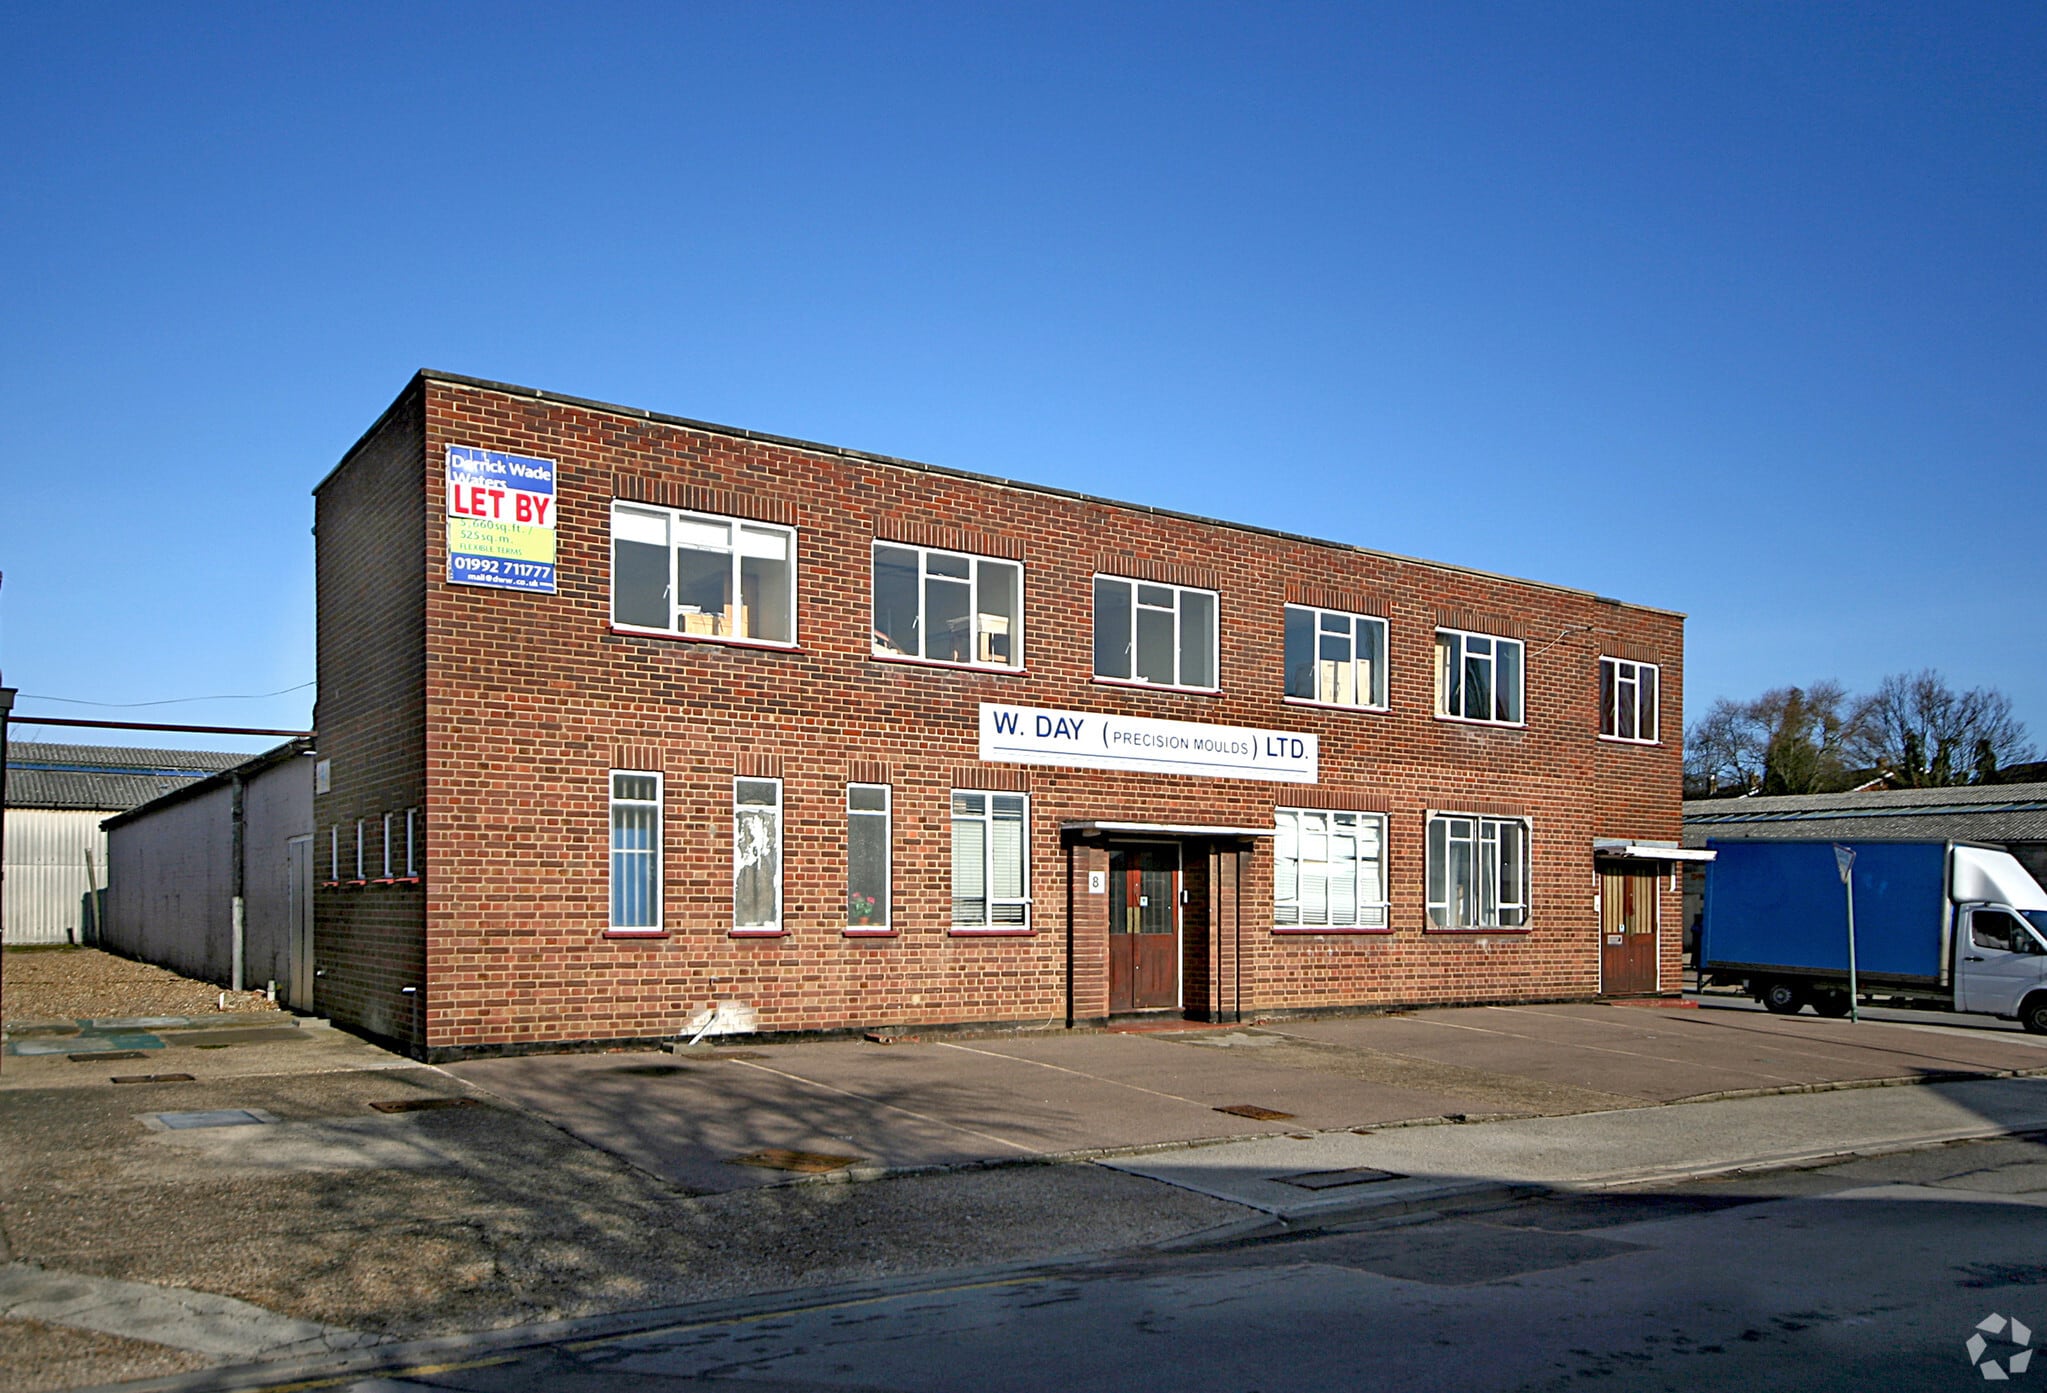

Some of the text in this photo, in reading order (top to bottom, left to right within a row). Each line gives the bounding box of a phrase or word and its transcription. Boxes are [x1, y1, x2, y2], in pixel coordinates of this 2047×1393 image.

[453, 471, 508, 489] Waters
[508, 462, 552, 481] Wade
[455, 484, 550, 525] LET BY
[454, 556, 551, 579] 01992 711777
[993, 711, 1024, 736] W.
[1036, 715, 1084, 740] DAY
[1266, 736, 1309, 760] LTD.
[1092, 875, 1099, 888] 8
